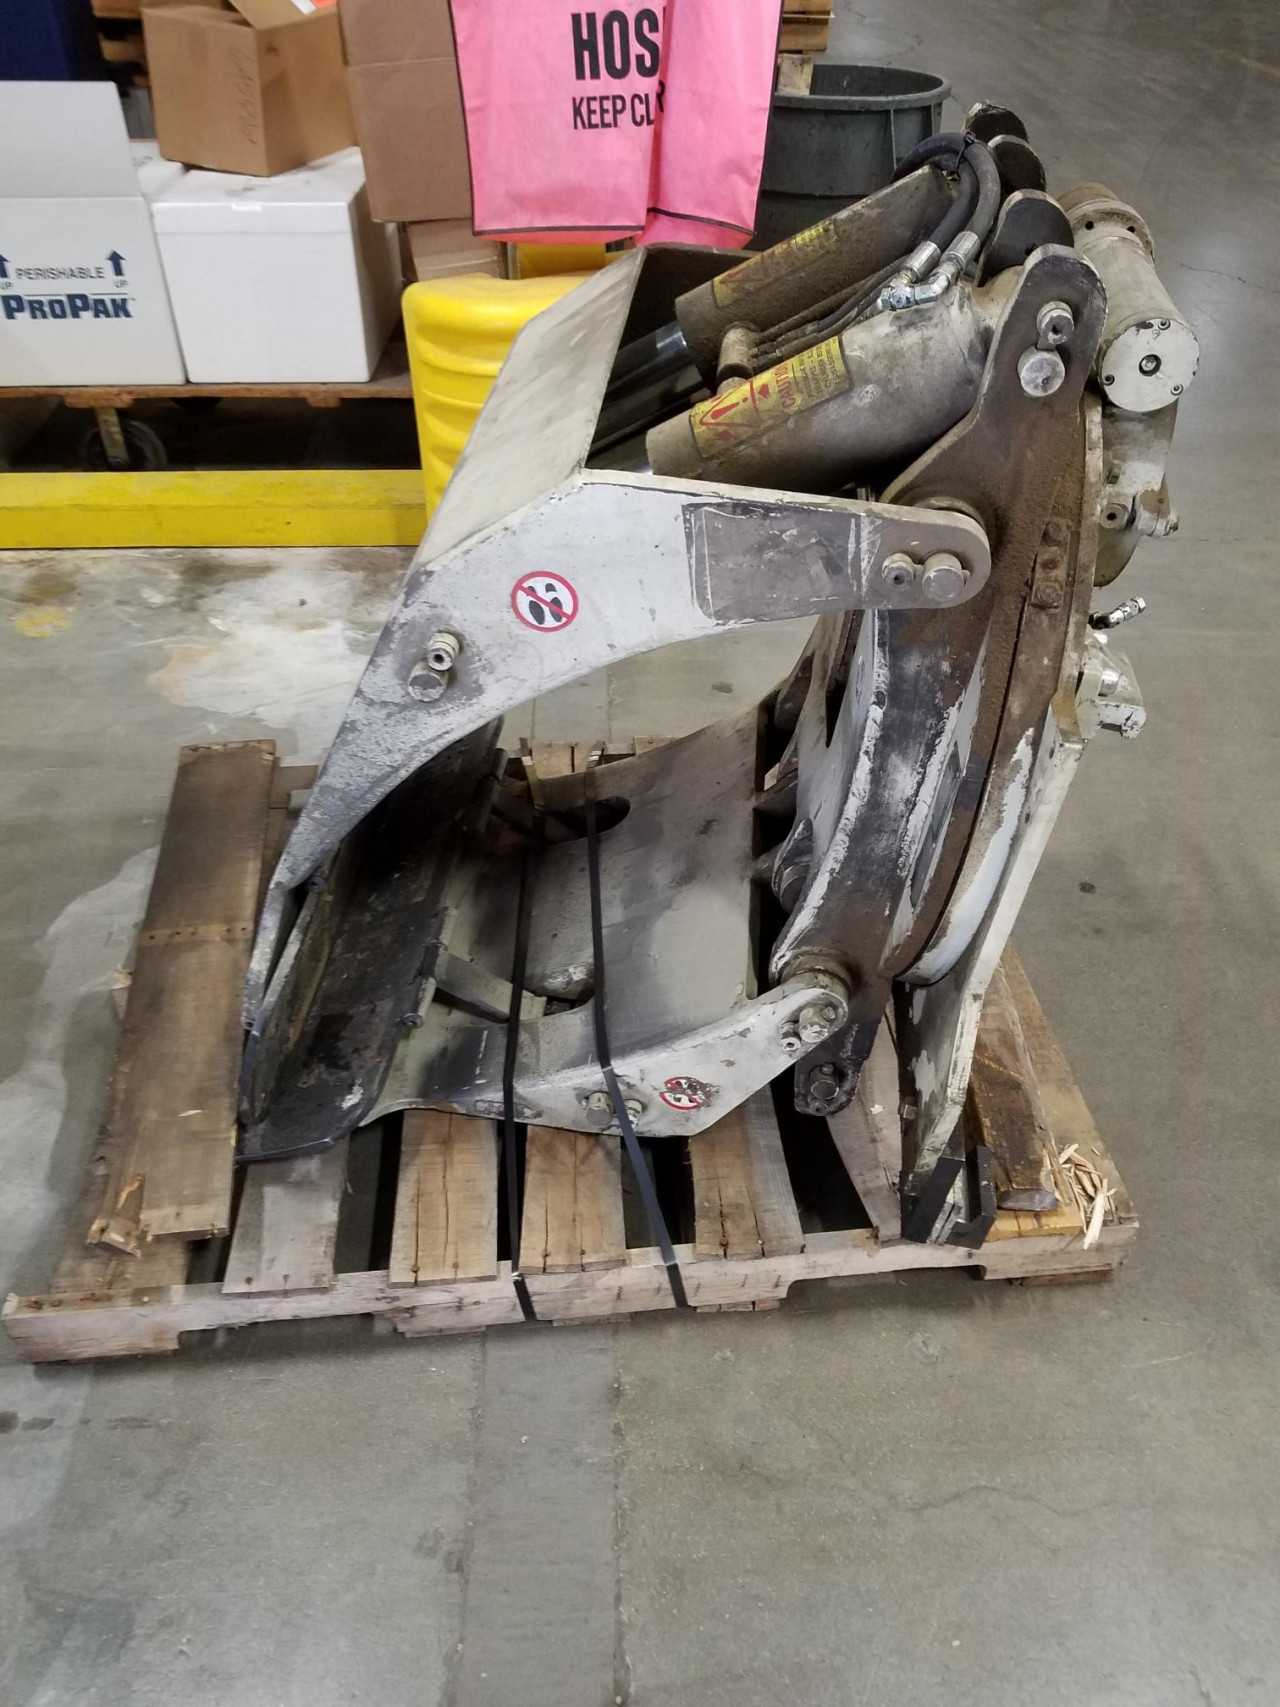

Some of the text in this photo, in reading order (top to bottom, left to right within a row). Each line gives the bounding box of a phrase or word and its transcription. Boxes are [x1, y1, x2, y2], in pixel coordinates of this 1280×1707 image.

[571, 8, 662, 80] HOS
[572, 94, 627, 130] KEEP
[15, 266, 105, 280] PERISHABLE
[774, 364, 798, 409] CAUTI
